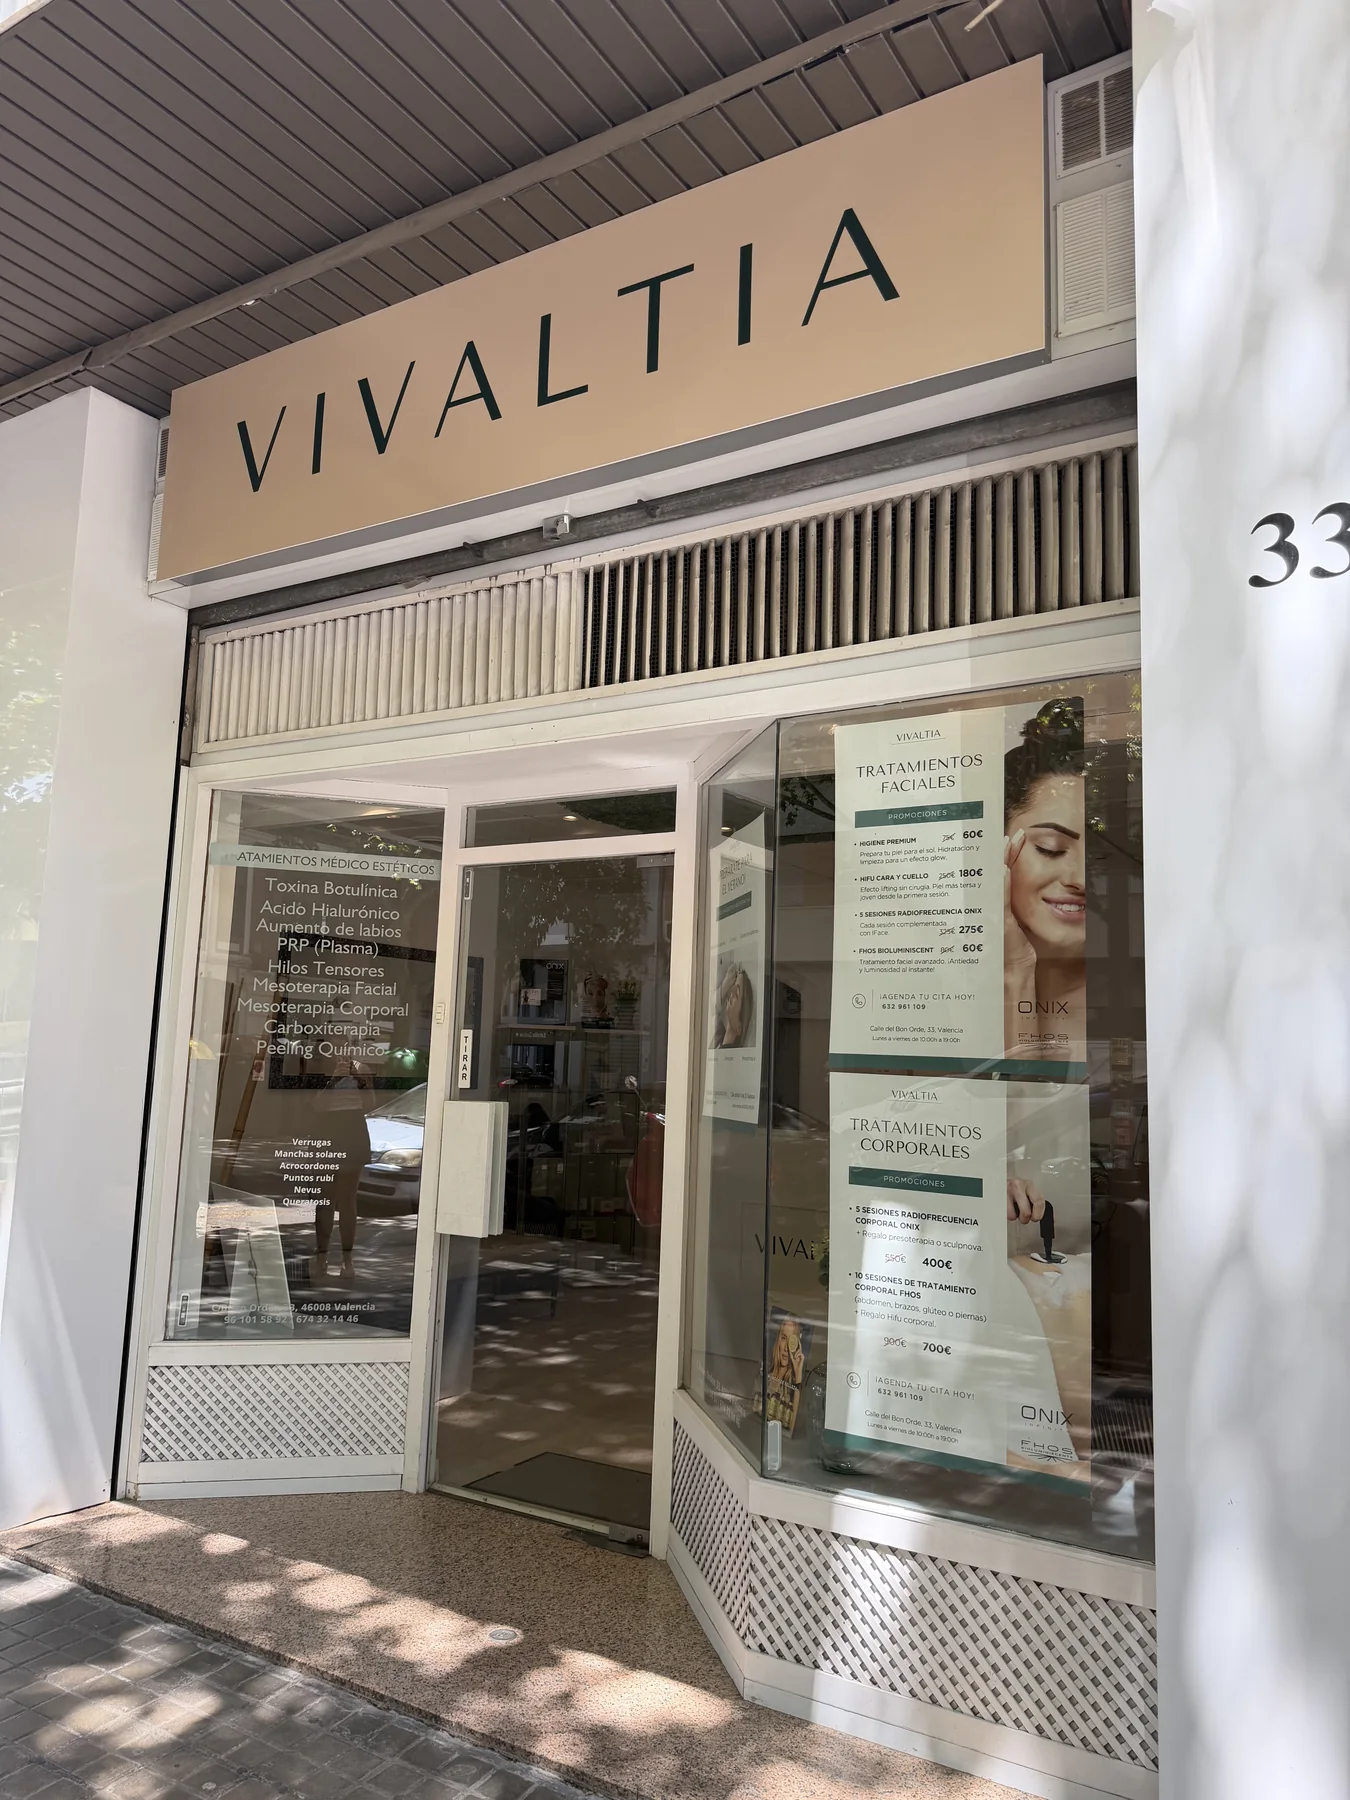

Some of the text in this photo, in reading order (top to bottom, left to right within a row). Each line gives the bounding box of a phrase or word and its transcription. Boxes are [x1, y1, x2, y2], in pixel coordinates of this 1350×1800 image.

[237, 207, 900, 493] VIVALTIA
[1248, 502, 1350, 588] 33
[896, 729, 941, 742] VIVALTIA
[856, 753, 983, 778] TRATAMIENTOS
[881, 775, 956, 794] FACIALES
[888, 809, 948, 820] PROMOCIONES
[963, 830, 983, 839] 60€
[224, 852, 435, 875] ATAMIENTOS MÉDICO ESTÉTICOS
[959, 868, 983, 877] 180€
[265, 877, 398, 899] Toxina Botulínica
[312, 902, 400, 920] Hialurónico
[256, 918, 402, 938] Aumento de labios
[959, 925, 983, 934] 275€
[277, 937, 379, 959] PRP (Plasma)
[963, 944, 983, 952] 60€
[268, 959, 385, 977] Hilos Tensores
[253, 978, 397, 998] Mesoterapia Facial
[237, 997, 409, 1019] Mesoterapia Corporal
[1018, 1001, 1069, 1014] ONIX
[264, 1019, 381, 1039] Carboxiterapia
[257, 1040, 385, 1059] Peeling Químico
[461, 1035, 469, 1081] TIRAR
[891, 1090, 938, 1101] VIVALTIA
[849, 1117, 982, 1140] TRATAMIENTOS
[292, 1138, 332, 1148] Verrugas
[860, 1138, 970, 1159] CORPORALES
[275, 1150, 347, 1159] Manchas solares
[279, 1162, 340, 1170] Acrocordones
[283, 1173, 334, 1182] Puntos rubí
[883, 1175, 945, 1188] PROMOCIONES
[294, 1186, 321, 1194] Nevus
[282, 1197, 330, 1207] Queratosis
[855, 1217, 920, 1231] CORPORAL ONIX
[862, 1207, 899, 1217] SESIONES
[901, 1211, 979, 1226] RADIOFRECUENCIA
[862, 1230, 887, 1240] Regalo
[889, 1234, 935, 1246] presoterapia
[943, 1241, 984, 1252] sculpnova.
[922, 1257, 953, 1270] 400€
[855, 1283, 921, 1299] CORPORAL FHOS
[865, 1273, 903, 1285] SESIONES
[904, 1279, 916, 1287] DE
[917, 1280, 976, 1295] TRATAMIENTO
[301, 1302, 376, 1311] 46008 Valencia
[854, 1296, 893, 1309] (abdomen,
[895, 1302, 920, 1313] brazos,
[923, 1306, 946, 1317] glúteo
[956, 1311, 987, 1323] piernas)
[224, 1316, 236, 1324] 96
[240, 1315, 257, 1324] 101
[260, 1315, 272, 1323] 58
[275, 1315, 287, 1323] 92
[296, 1315, 314, 1323] 674
[317, 1315, 329, 1323] 32
[332, 1315, 344, 1323] 14
[860, 1309, 937, 1328] Regalo Hifu corporal.
[923, 1341, 951, 1355] 700€
[875, 1376, 913, 1389] ¡AGENDA
[930, 1386, 950, 1396] CITA
[952, 1390, 975, 1400] HOY!
[877, 1388, 891, 1396] 632
[894, 1390, 907, 1398] 961
[865, 1409, 880, 1418] Calle
[892, 1415, 904, 1423] Bon
[905, 1418, 922, 1427] Orde,
[934, 1423, 962, 1434] Valencia
[1021, 1405, 1073, 1427] ONIX
[868, 1421, 883, 1430] Lunes
[888, 1425, 907, 1434] viernes
[1021, 1440, 1073, 1455] FHOS
